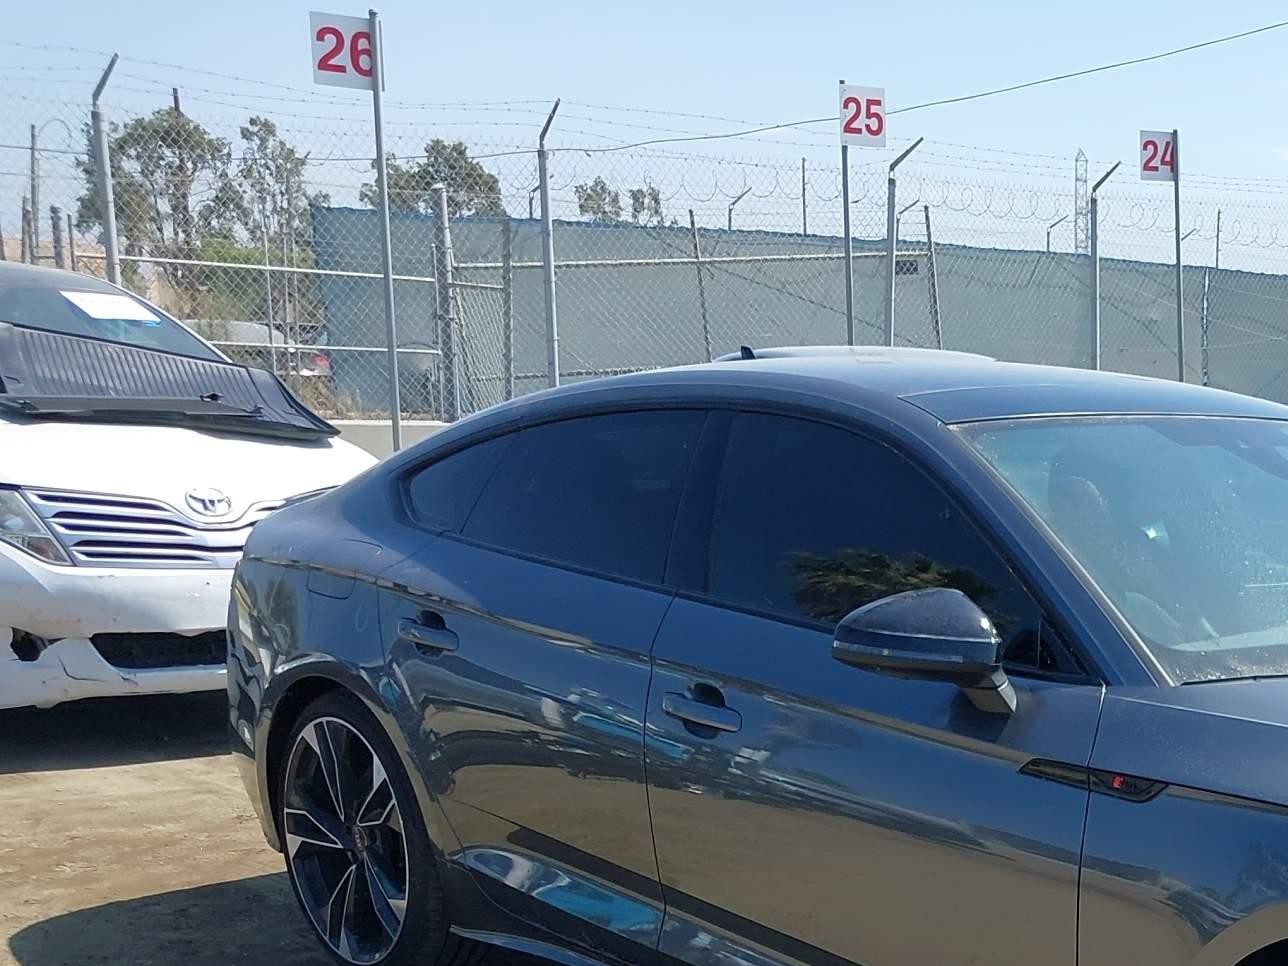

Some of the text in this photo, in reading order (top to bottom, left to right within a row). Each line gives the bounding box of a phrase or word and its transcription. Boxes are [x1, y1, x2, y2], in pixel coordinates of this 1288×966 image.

[315, 26, 373, 78] 26
[843, 96, 883, 136] 25
[1142, 140, 1174, 173] 24
